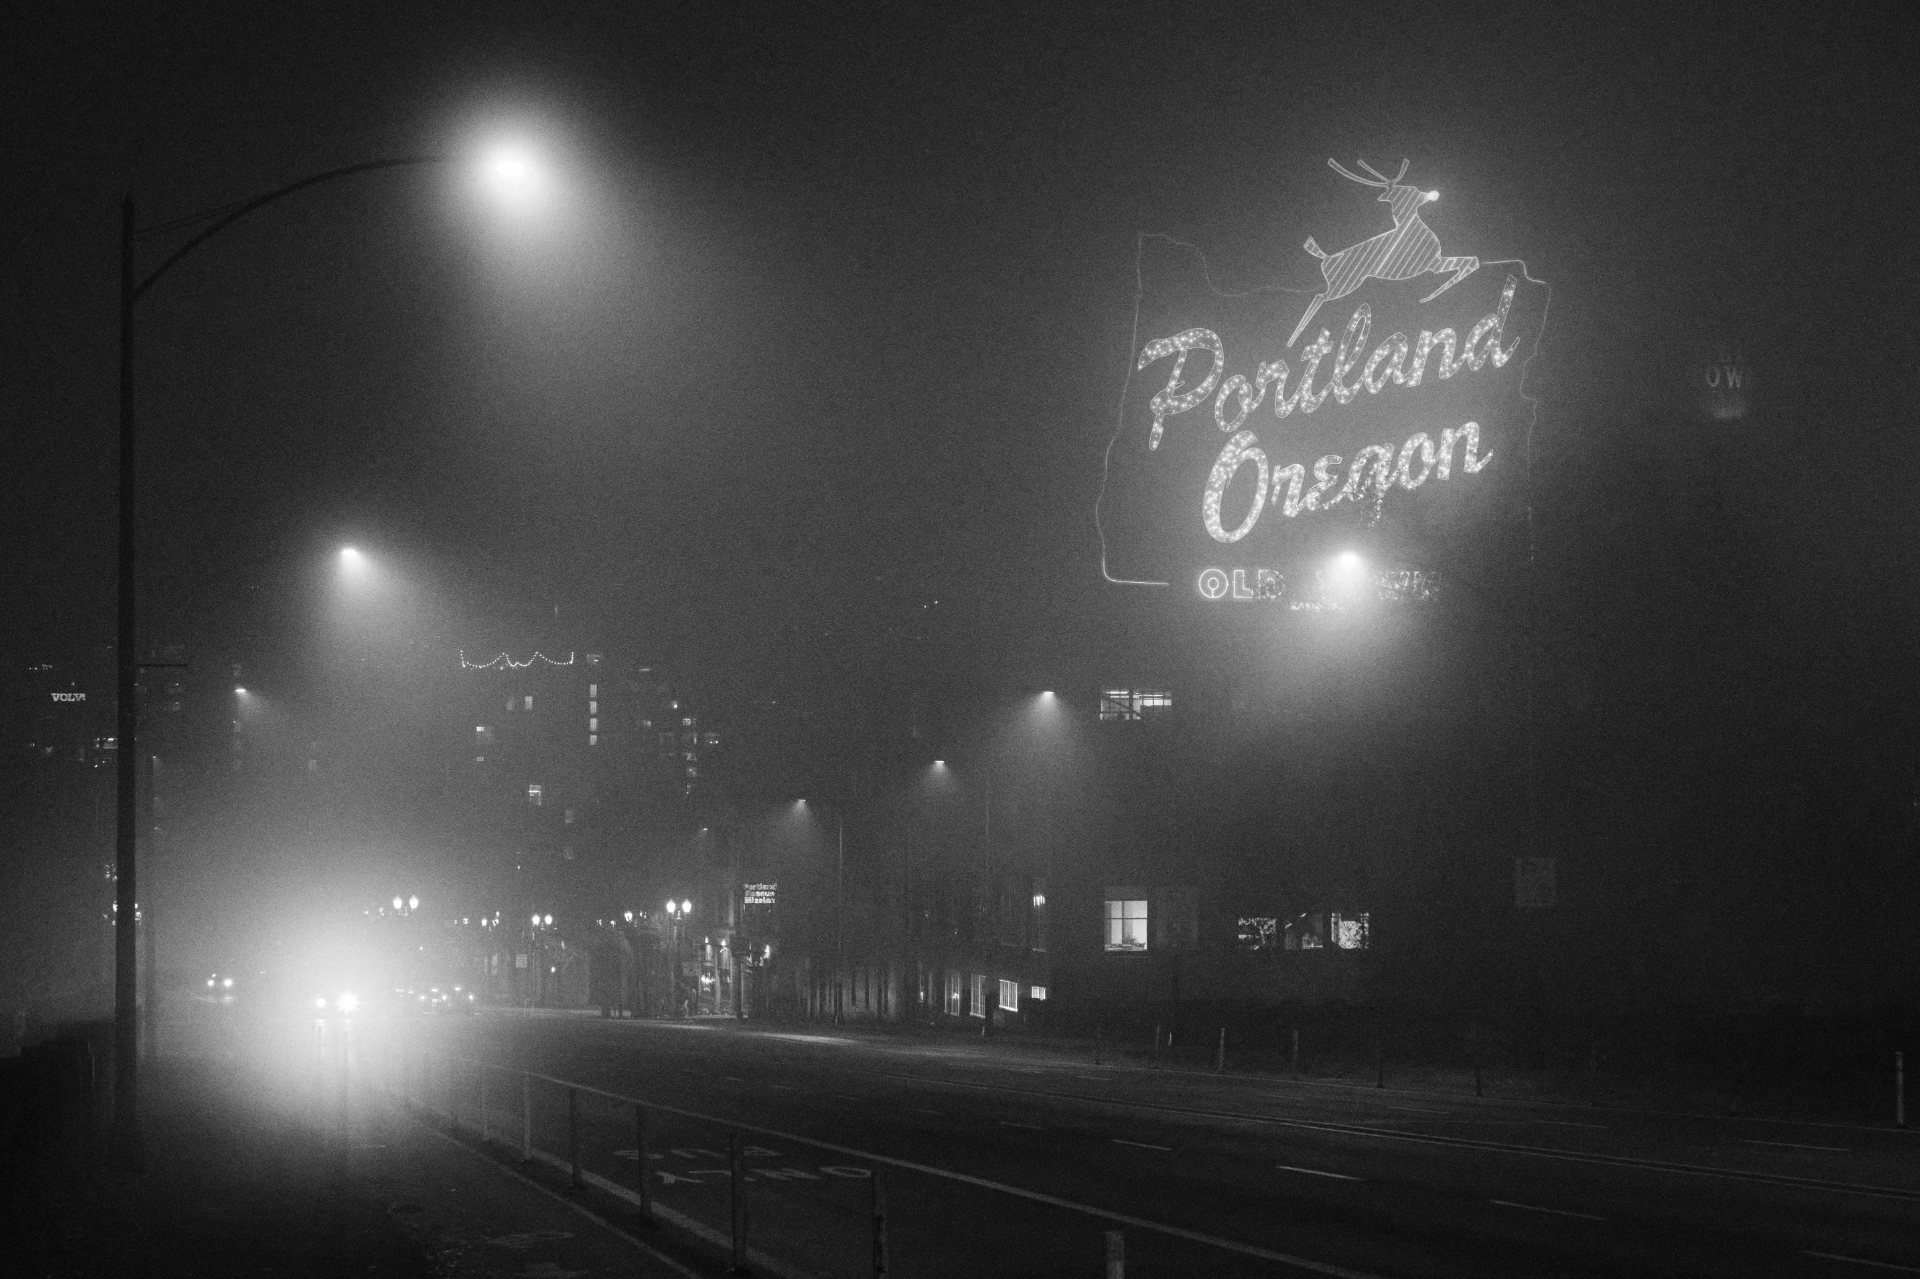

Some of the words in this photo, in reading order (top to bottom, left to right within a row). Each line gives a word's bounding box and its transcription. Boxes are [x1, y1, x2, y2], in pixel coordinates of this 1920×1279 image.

[1137, 275, 1519, 451] Portland
[1202, 420, 1494, 544] Oregon
[1198, 568, 1285, 600] OLD
